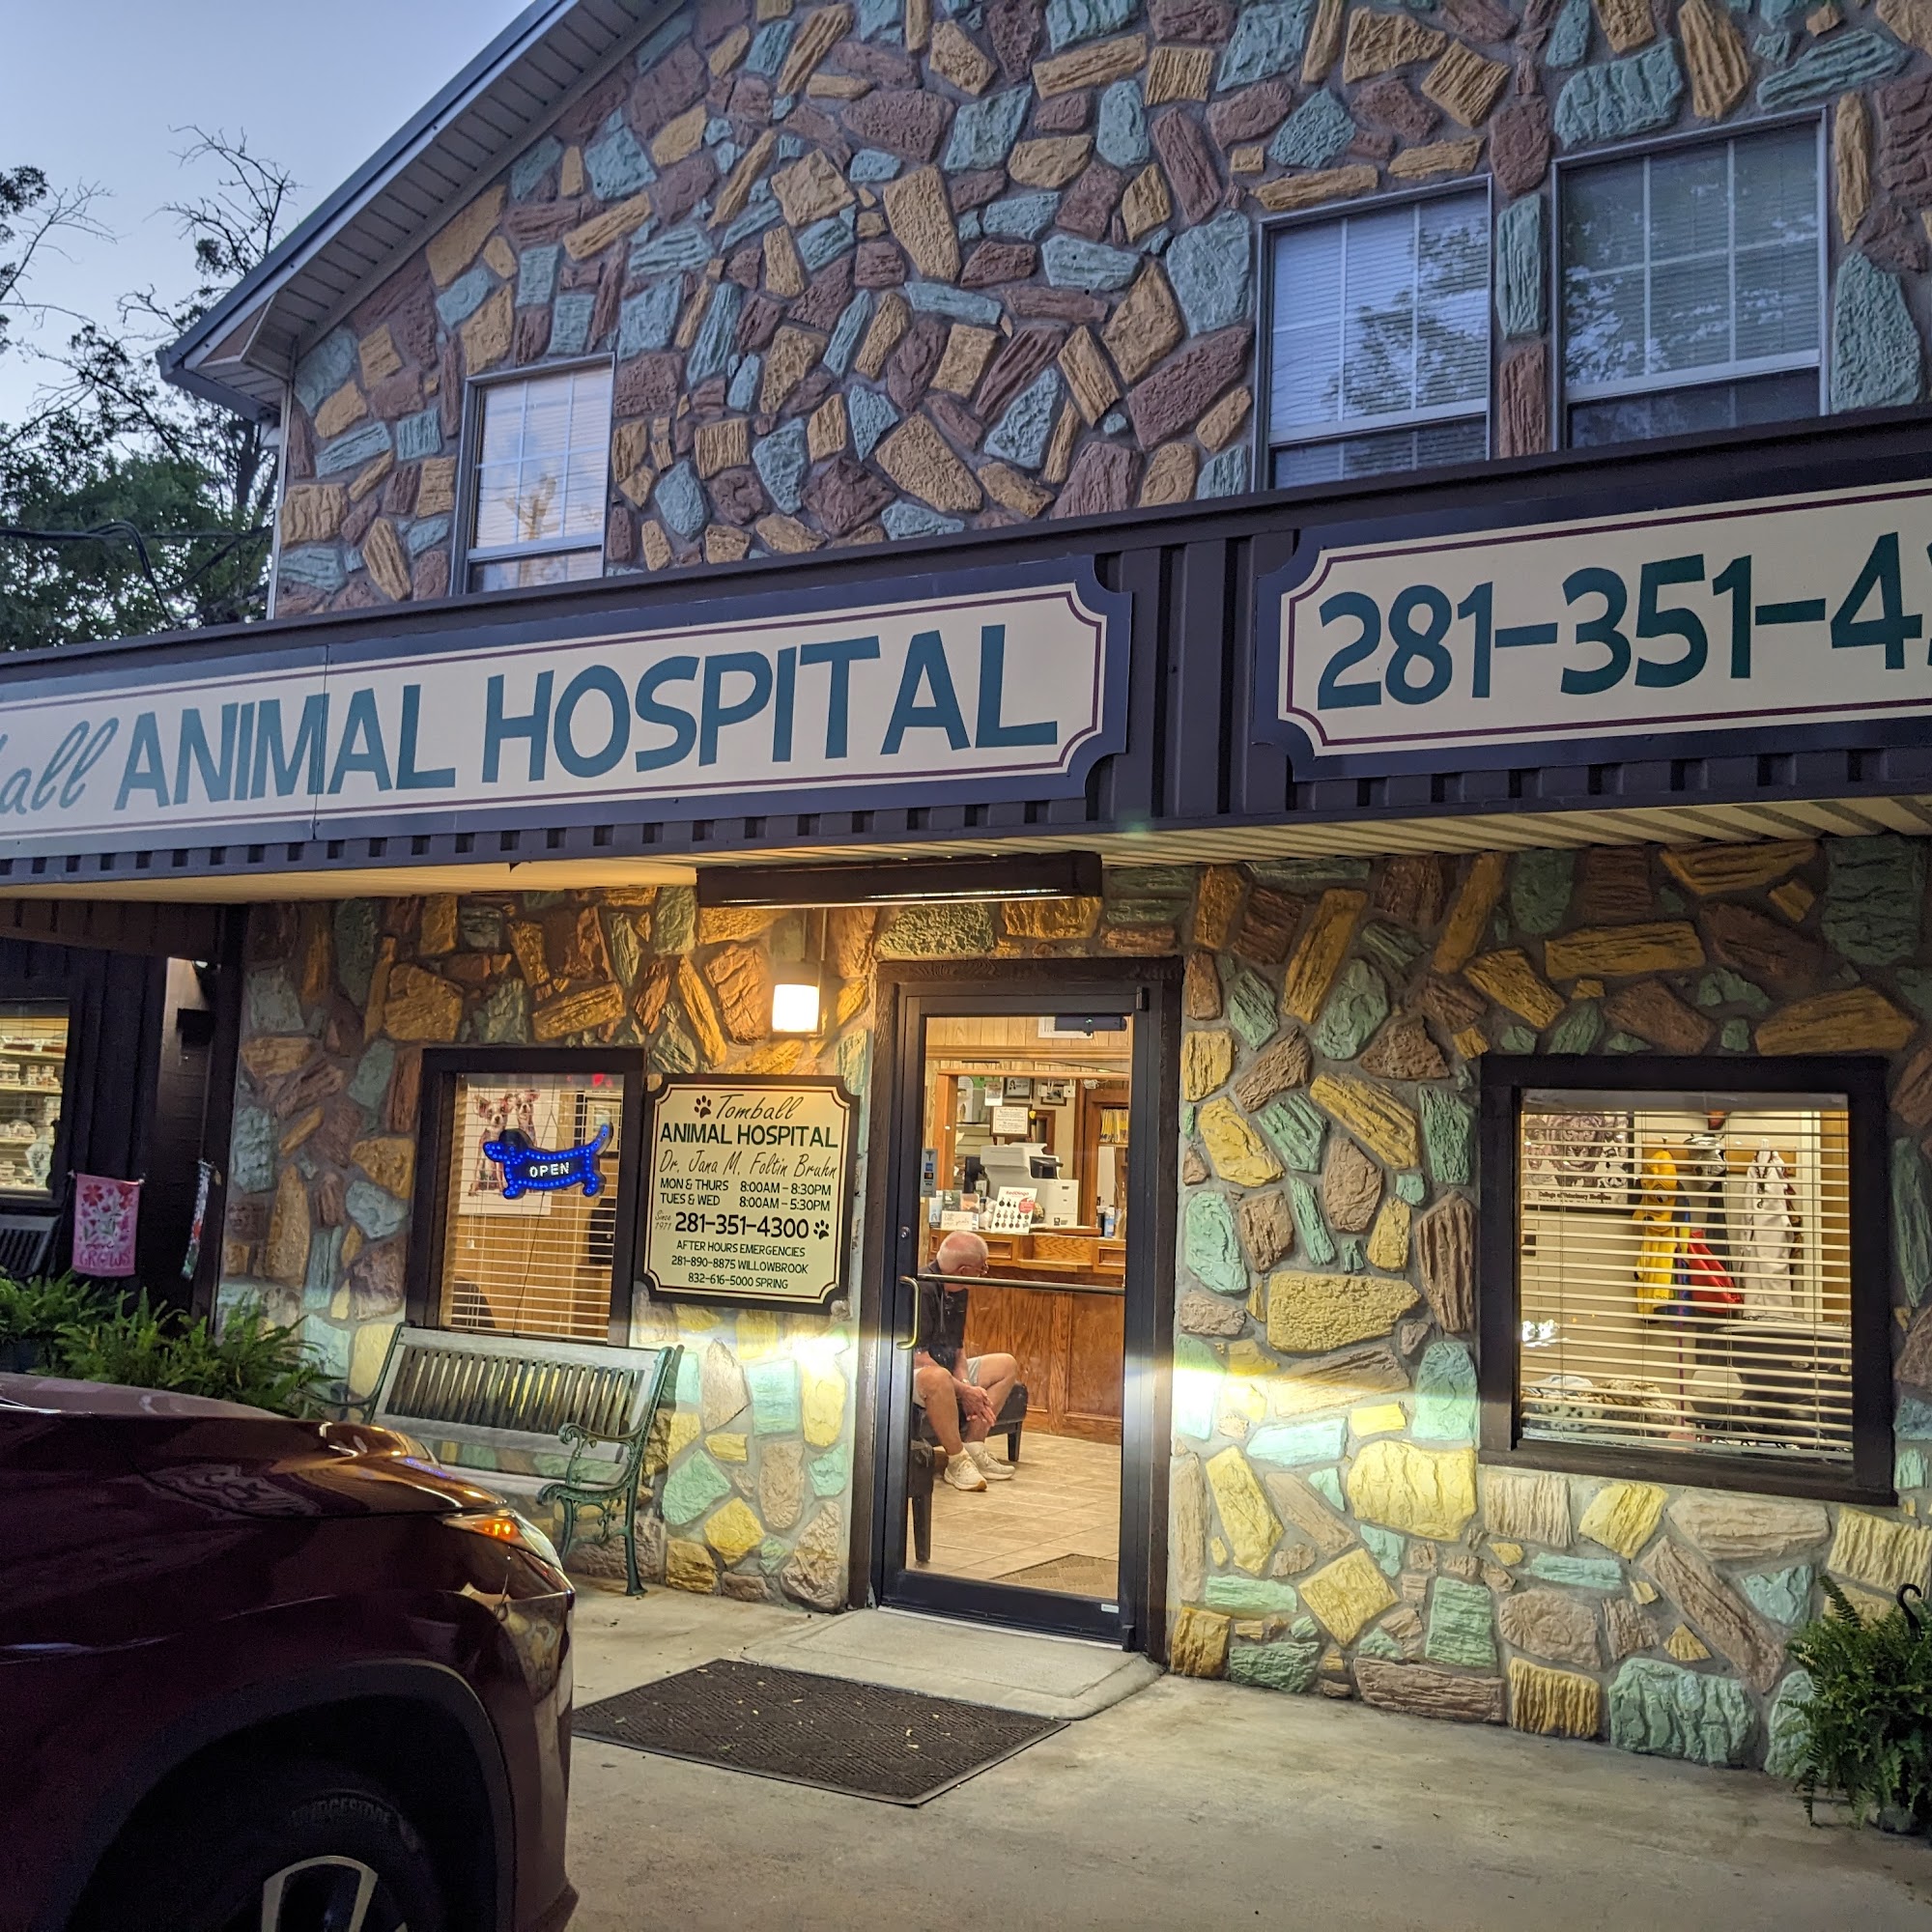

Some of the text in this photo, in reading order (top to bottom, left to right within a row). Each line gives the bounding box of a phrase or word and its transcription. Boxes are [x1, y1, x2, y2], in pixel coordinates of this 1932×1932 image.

[1317, 531, 1932, 711] 281-351-4
[0, 623, 1058, 815] all ANIMAL HOSPITAL
[716, 1094, 805, 1121] Tomball
[660, 1122, 838, 1148] ANIMAL HOSPITAL
[528, 1161, 570, 1179] OPEN
[659, 1149, 838, 1179] Dr. Jana M. Foltin Bruhn
[660, 1178, 684, 1190] MON
[685, 1179, 694, 1190] &
[695, 1179, 729, 1191] THURS
[740, 1180, 781, 1194] 8:00AM
[790, 1183, 832, 1196] 8:30PM
[660, 1192, 686, 1205] TUES
[687, 1193, 696, 1205] &
[697, 1194, 721, 1207] WED
[739, 1196, 780, 1209] 8:00AM
[789, 1198, 831, 1211] 5:30PM
[654, 1209, 672, 1221] Since
[654, 1222, 672, 1232] 1971
[674, 1211, 810, 1239] 281-351-4300
[676, 1239, 806, 1258] AFTER HOURS EMERGENCIES
[671, 1255, 810, 1274] 281-890-8875 WILLOWBROOK
[688, 1271, 789, 1290] 832-616-5000 SPRING
